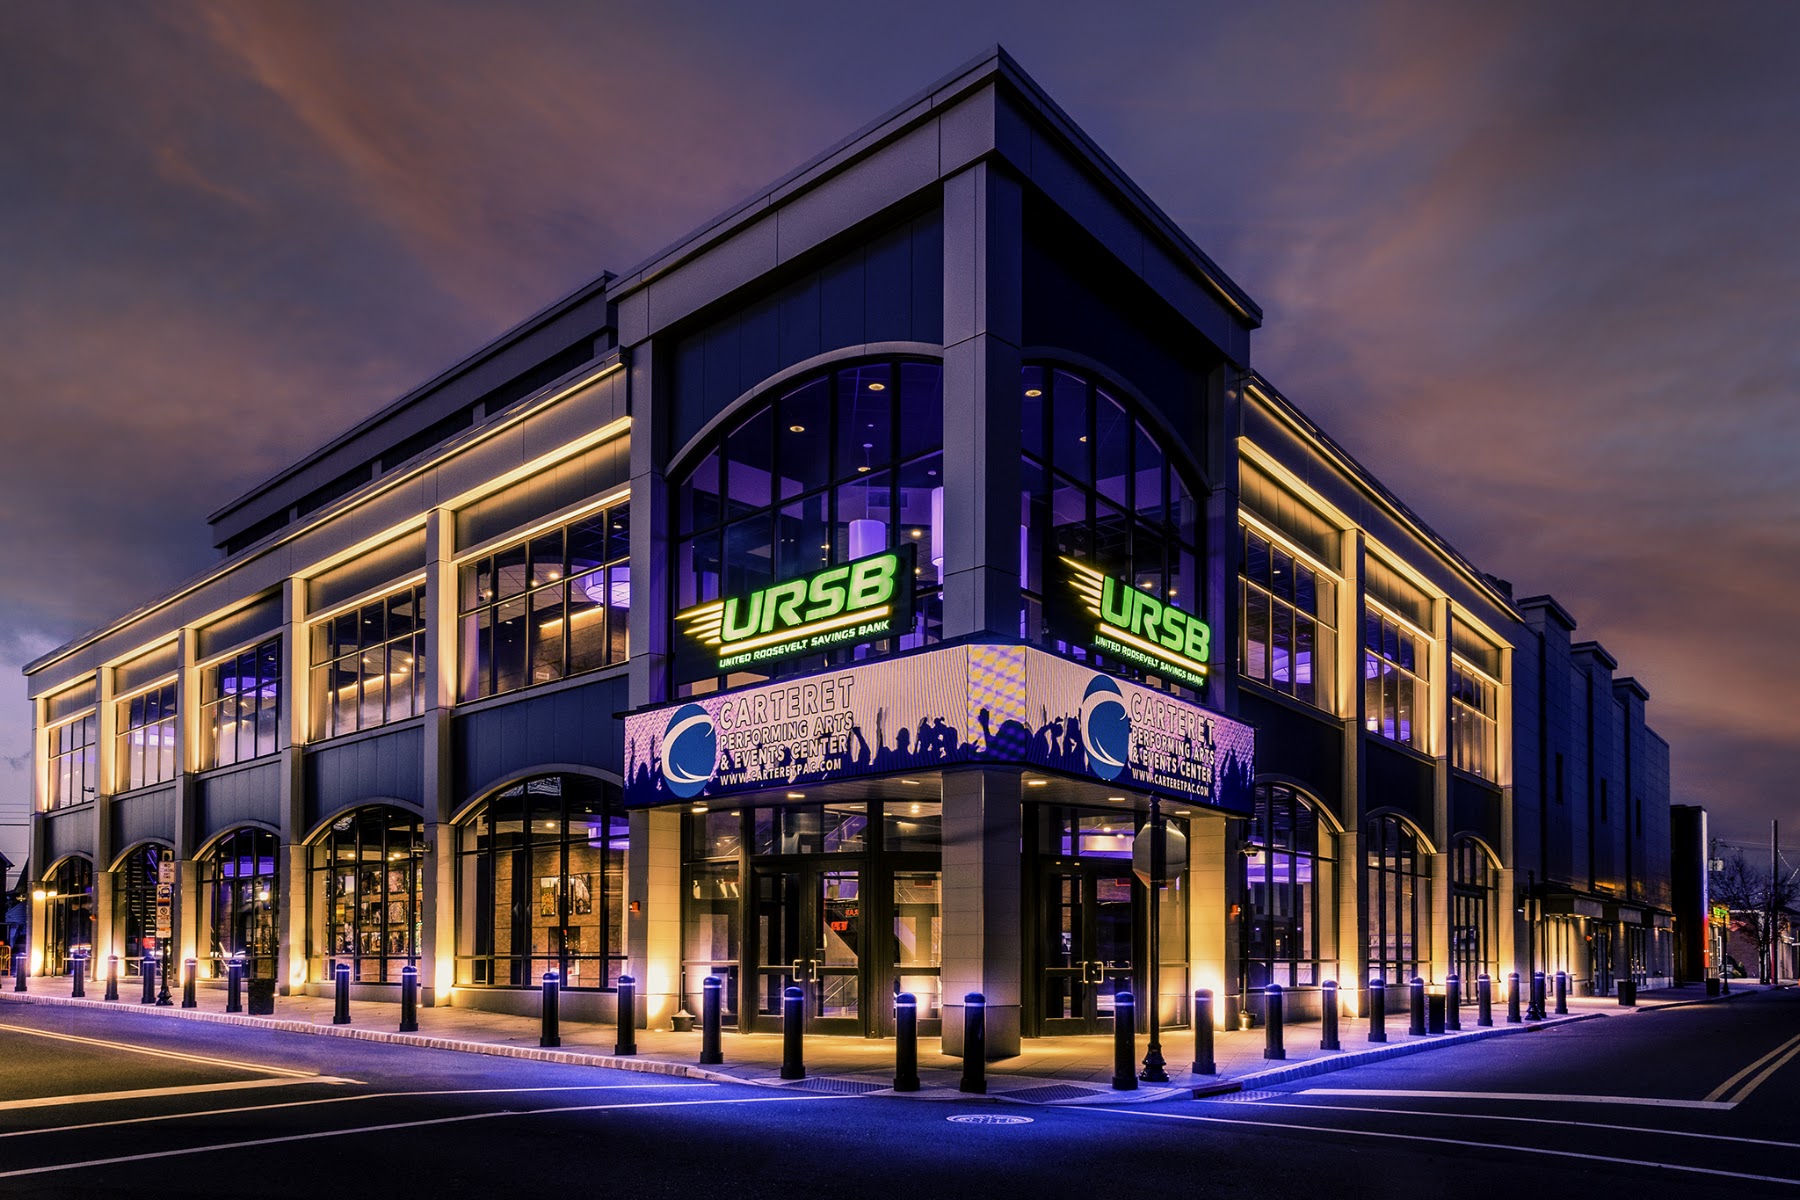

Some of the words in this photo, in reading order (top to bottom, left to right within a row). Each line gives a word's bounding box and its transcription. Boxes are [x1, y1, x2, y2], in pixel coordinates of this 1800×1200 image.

[721, 554, 898, 642] URSB
[1100, 575, 1211, 663] URSB
[719, 653, 751, 668] UNITED
[753, 639, 809, 660] ROOSEVELT
[810, 628, 856, 646] SAVINGS
[858, 620, 890, 635] BANK
[1095, 635, 1121, 652] UNITED
[1121, 645, 1159, 667] ROOSEVELT
[1160, 661, 1187, 678] SAVINGS
[1187, 672, 1204, 686] BANK
[719, 676, 854, 730] CARTERET
[1131, 693, 1215, 746] CARTERET
[720, 720, 808, 752] PERFORMING
[813, 711, 854, 736] ARTS
[720, 754, 730, 771] &
[734, 744, 785, 769] EVENTS
[791, 734, 848, 760] CENTER
[1132, 725, 1190, 758] PERFORMING
[1193, 745, 1214, 766] ARTS
[720, 758, 842, 786] WWW.CARTERETPAC.COM
[1132, 746, 1139, 764] &
[1143, 748, 1177, 774] EVENTS
[1180, 760, 1212, 783] CENTER
[1132, 768, 1209, 796] WWW.CARTERETPAC.COM
